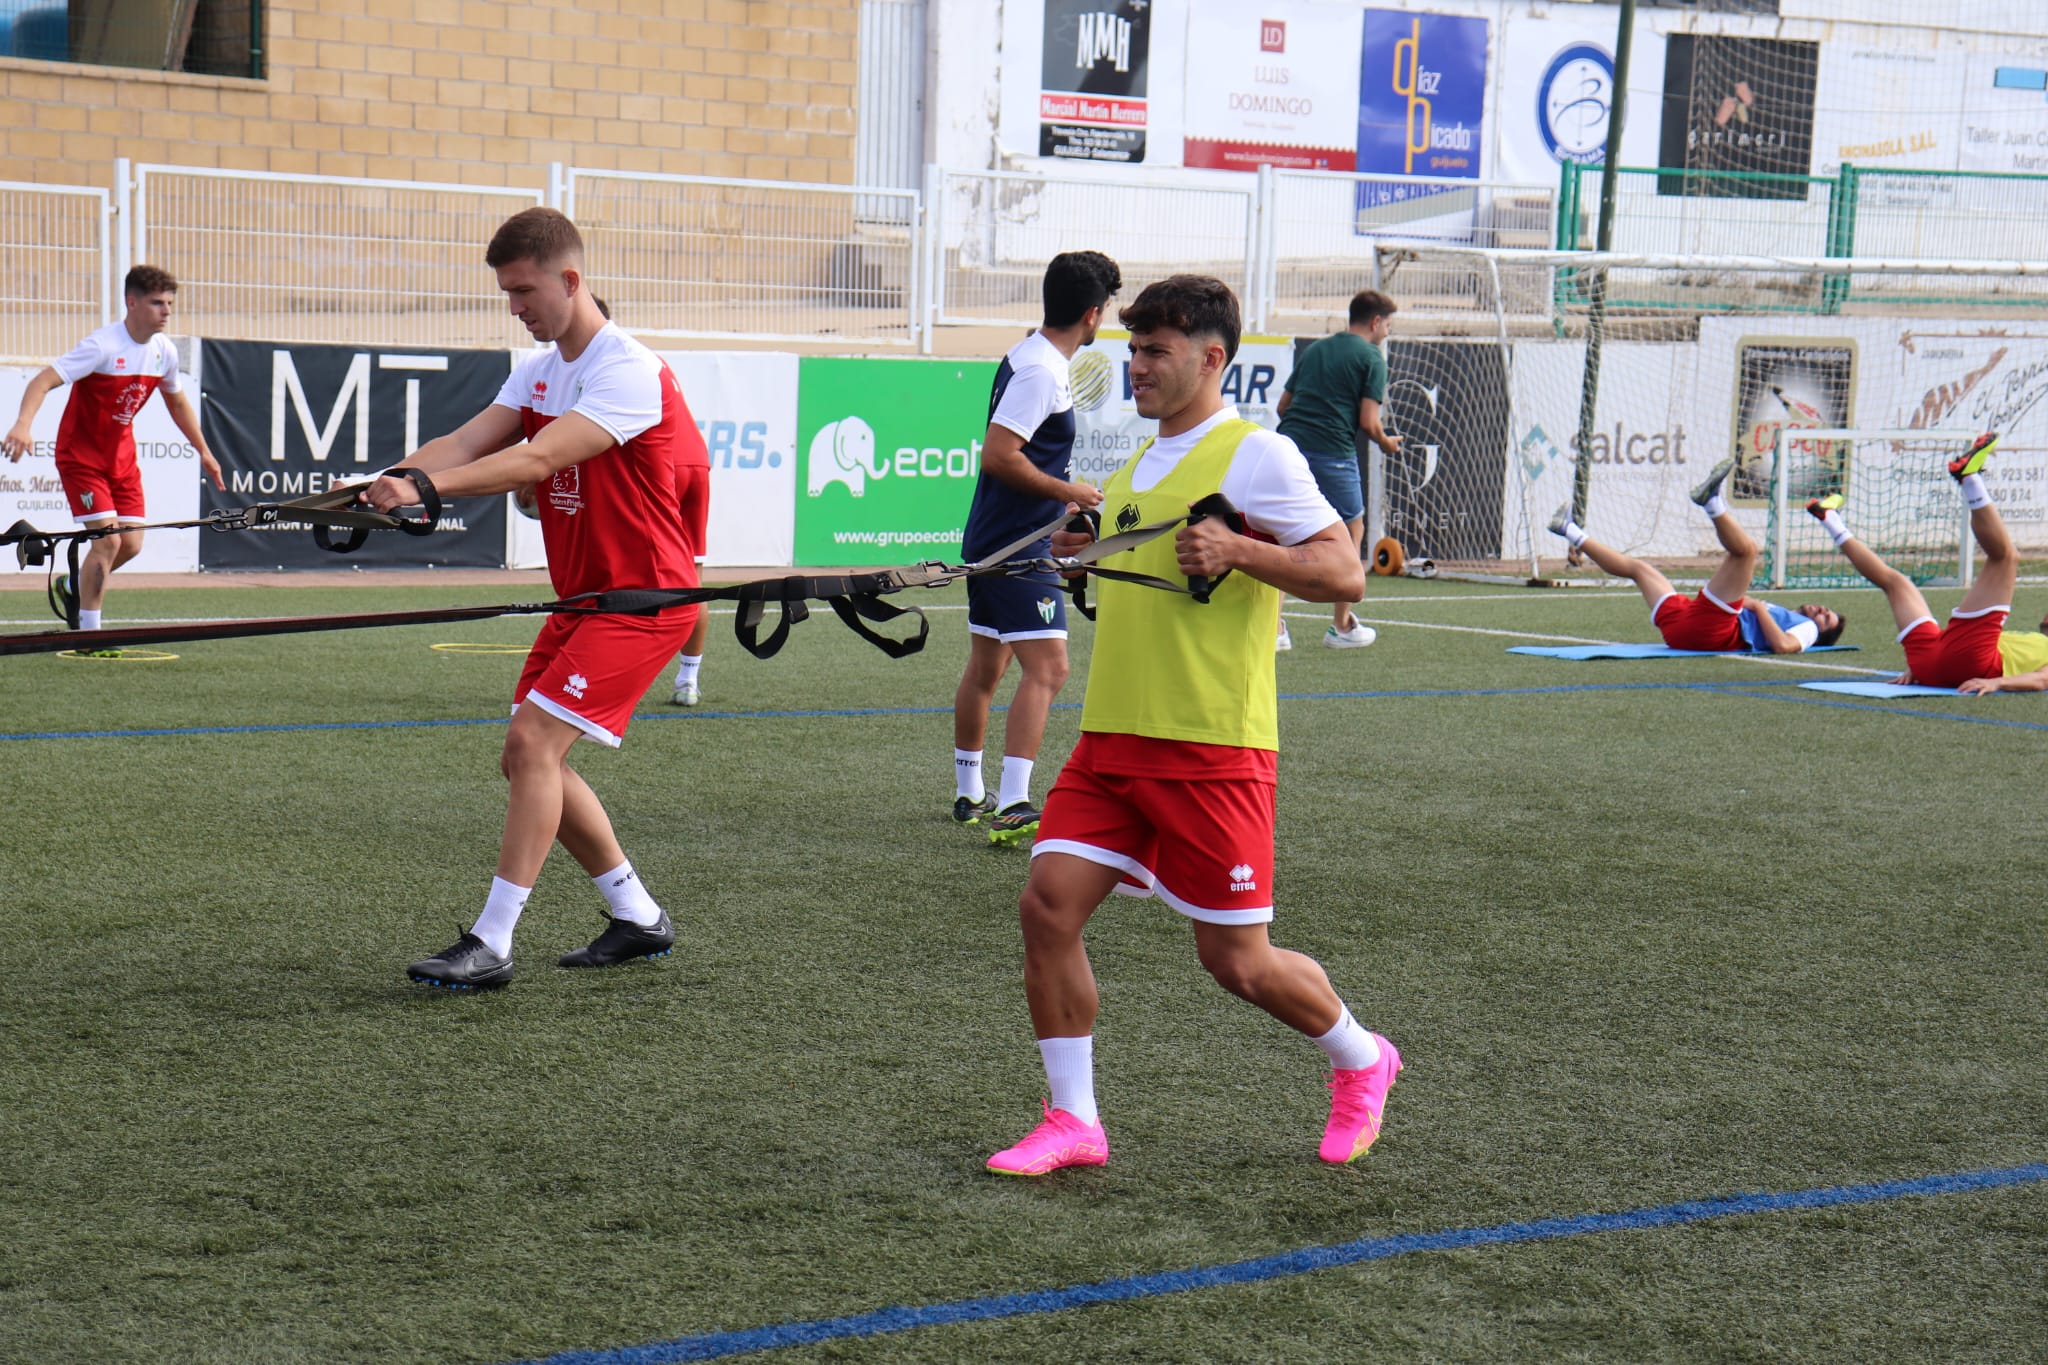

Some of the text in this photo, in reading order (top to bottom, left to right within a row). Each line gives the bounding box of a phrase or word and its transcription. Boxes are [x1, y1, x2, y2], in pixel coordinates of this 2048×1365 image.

[1255, 65, 1290, 85] LUIS
[1228, 92, 1313, 117] DOMINGO
[1966, 126, 1999, 144] Taller
[2004, 130, 2032, 146] Juan
[1091, 429, 1130, 449] flota
[139, 442, 194, 459] TIDOS
[17, 500, 63, 511] GUIJUELO
[1230, 881, 1256, 892] errea
